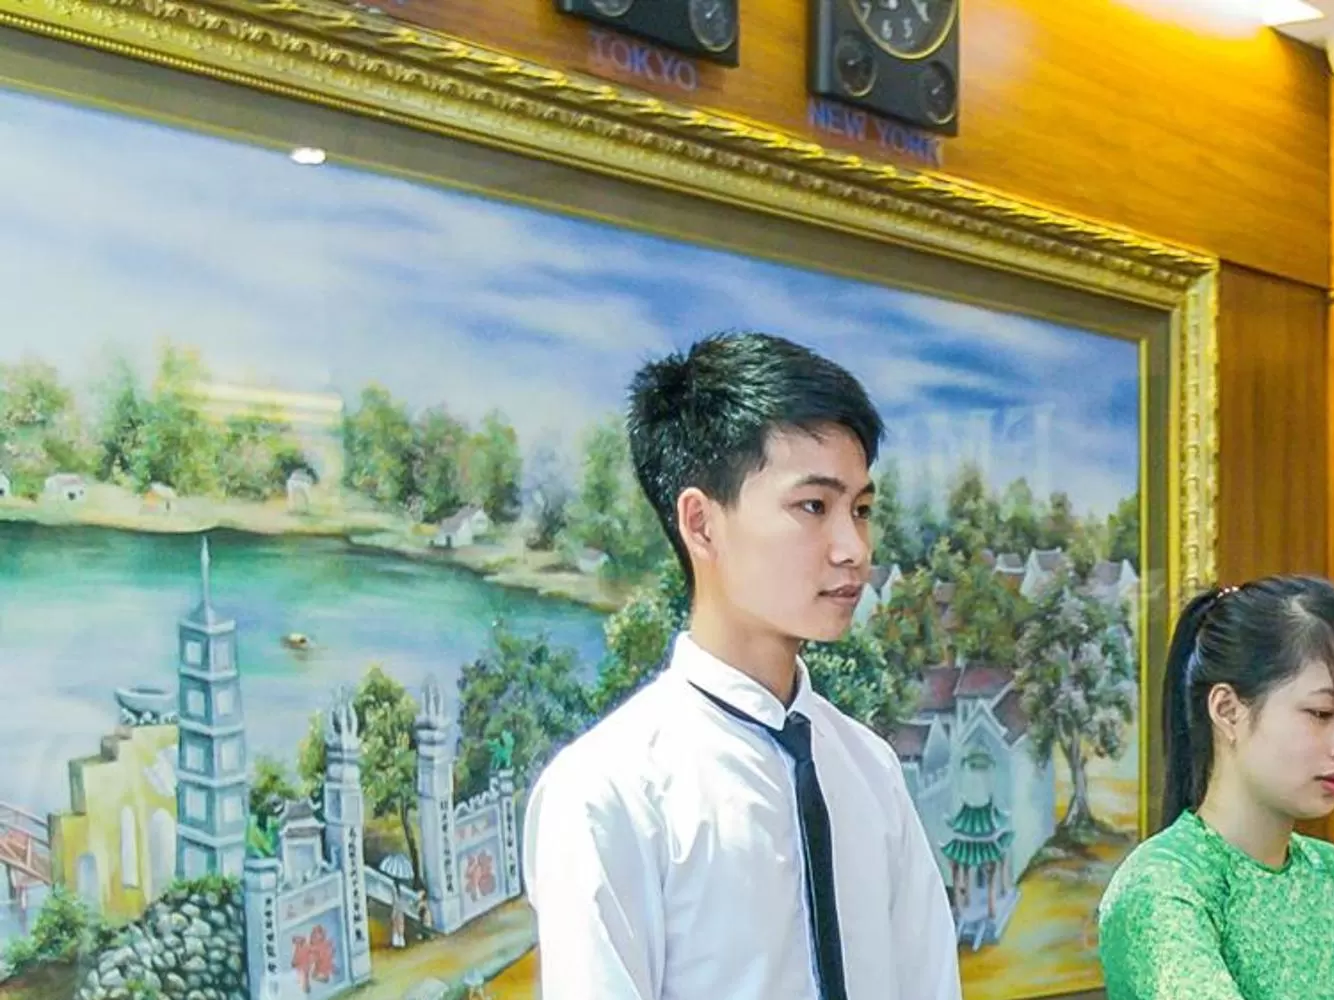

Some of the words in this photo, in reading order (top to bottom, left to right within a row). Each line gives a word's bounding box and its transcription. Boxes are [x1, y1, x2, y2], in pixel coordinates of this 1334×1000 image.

[588, 29, 697, 92] TOKYO
[808, 98, 867, 142] NEW
[874, 119, 943, 168] YORK
